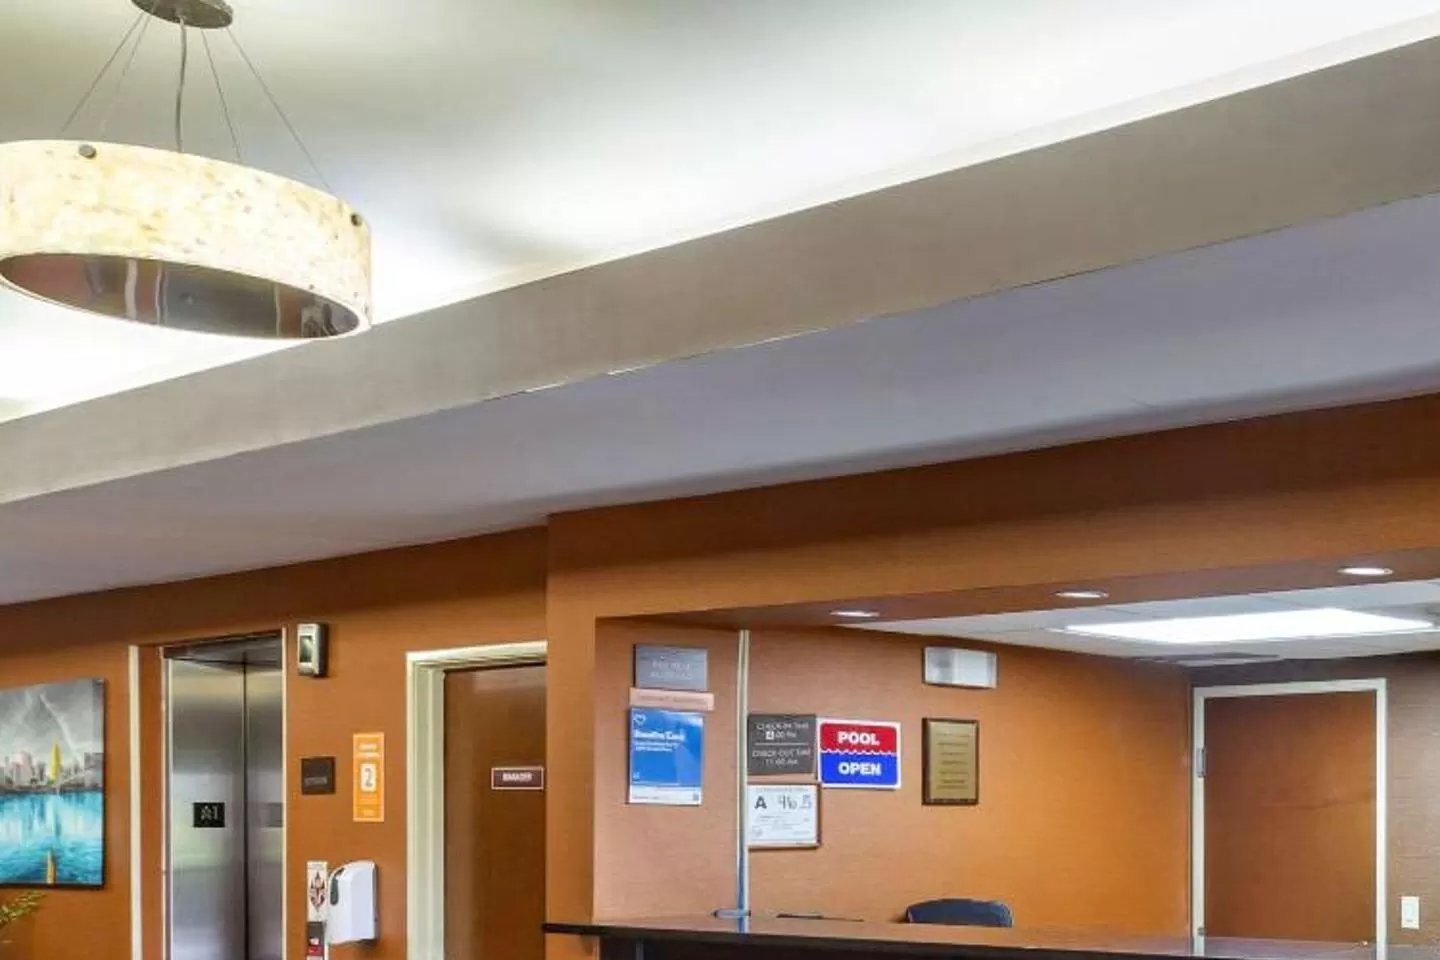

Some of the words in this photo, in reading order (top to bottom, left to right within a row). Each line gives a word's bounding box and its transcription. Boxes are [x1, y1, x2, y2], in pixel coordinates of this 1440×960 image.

[838, 731, 880, 745] POOL
[838, 762, 881, 775] OPEN
[754, 796, 768, 809] A
